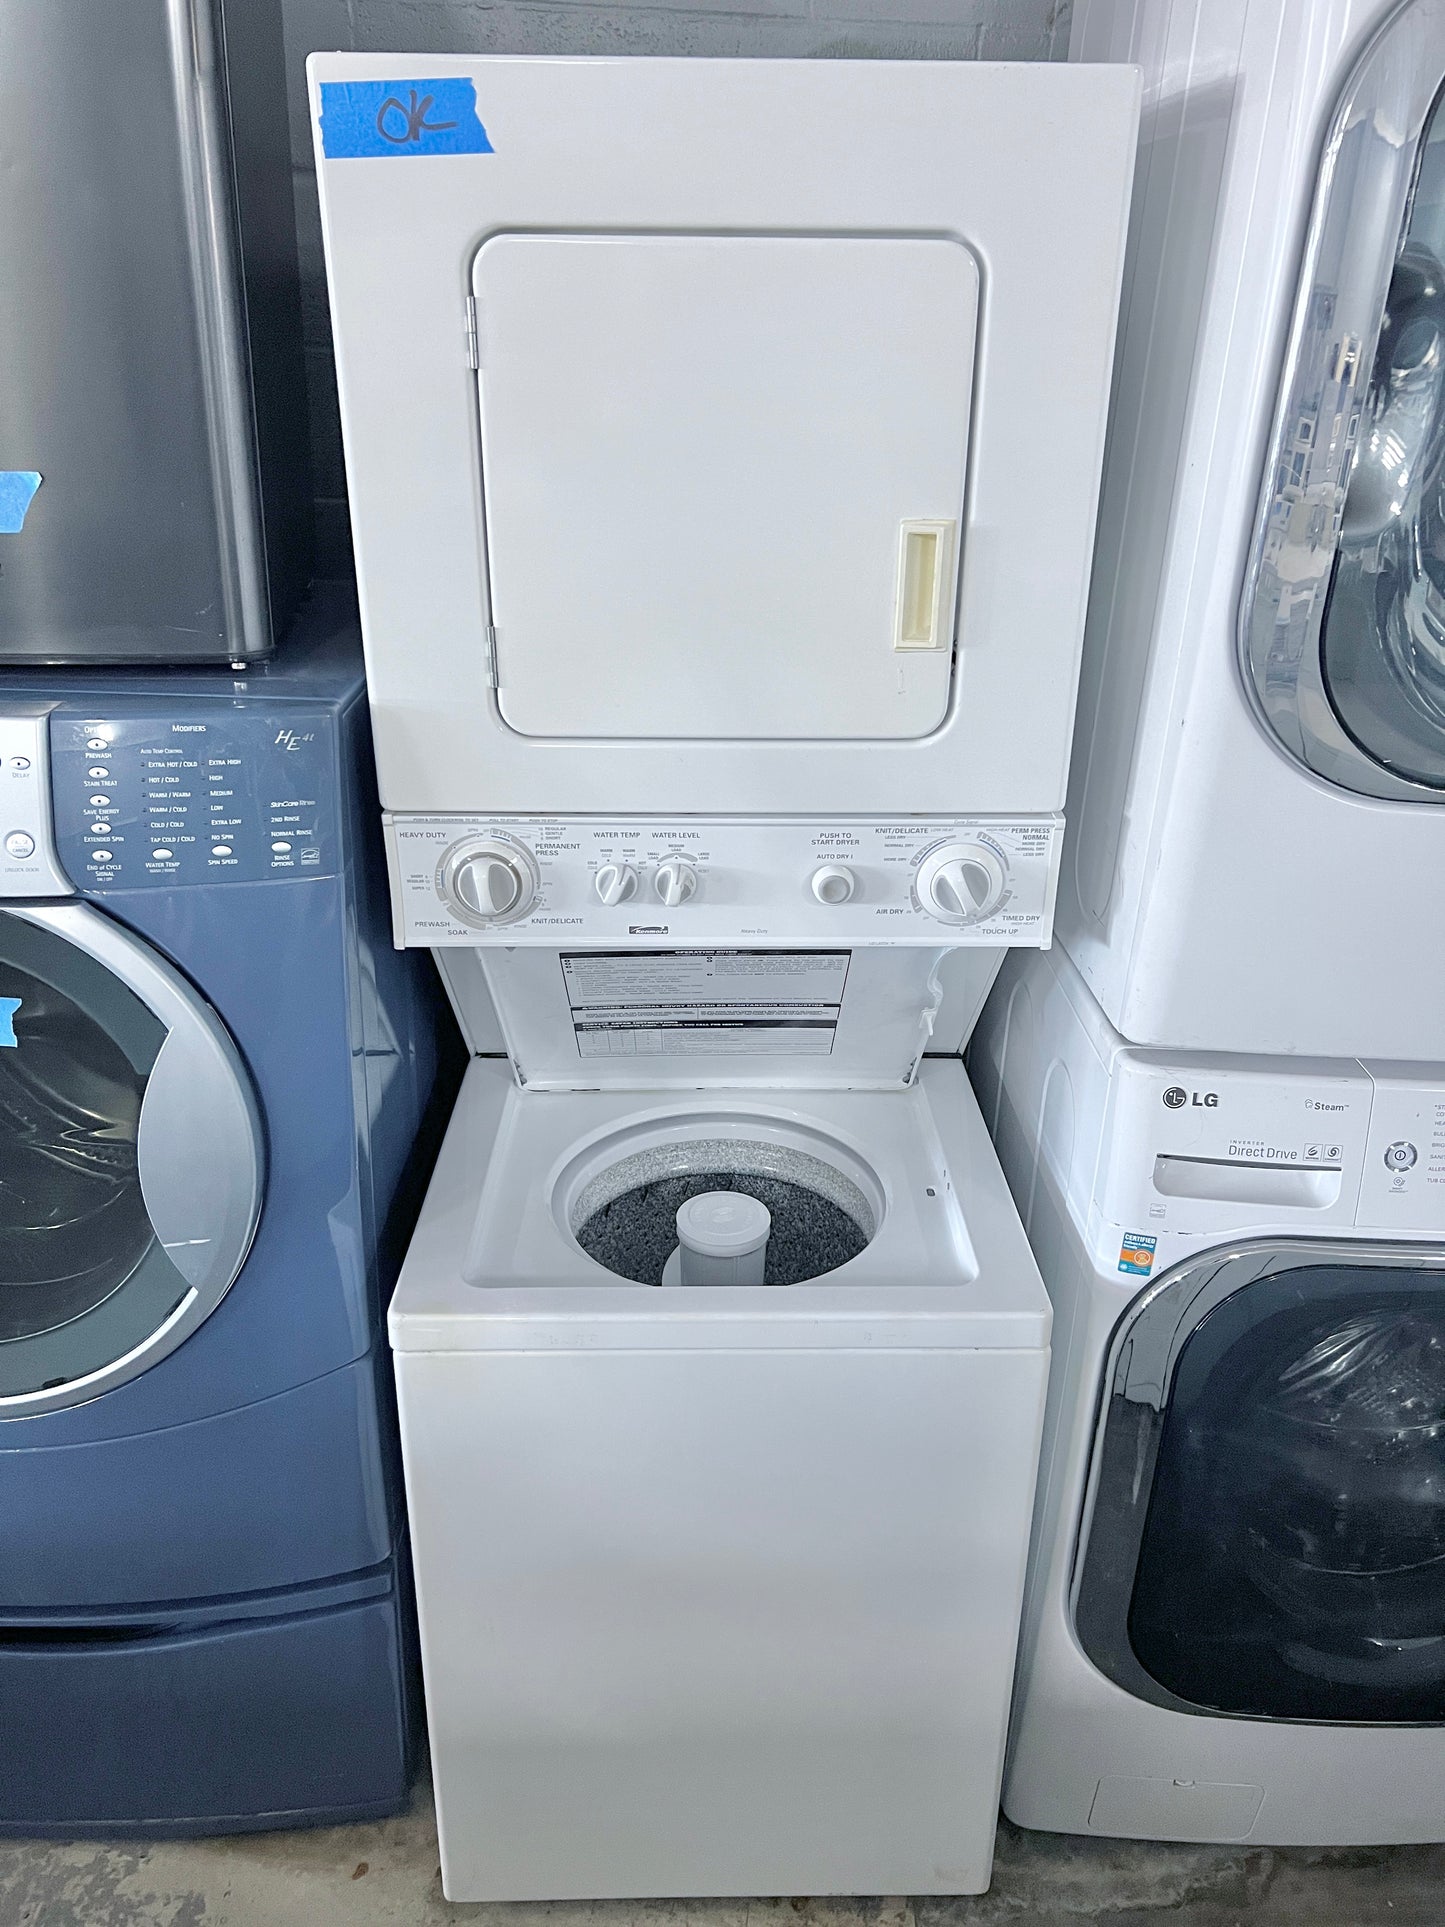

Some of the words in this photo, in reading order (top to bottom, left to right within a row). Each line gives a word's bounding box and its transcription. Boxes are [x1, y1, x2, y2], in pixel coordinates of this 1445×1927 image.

[377, 89, 458, 143] OK
[1192, 1092, 1218, 1107] LG
[1229, 1145, 1264, 1157] Direct
[1266, 1148, 1298, 1159] Drive
[1125, 1234, 1155, 1244] CERTIFIED
